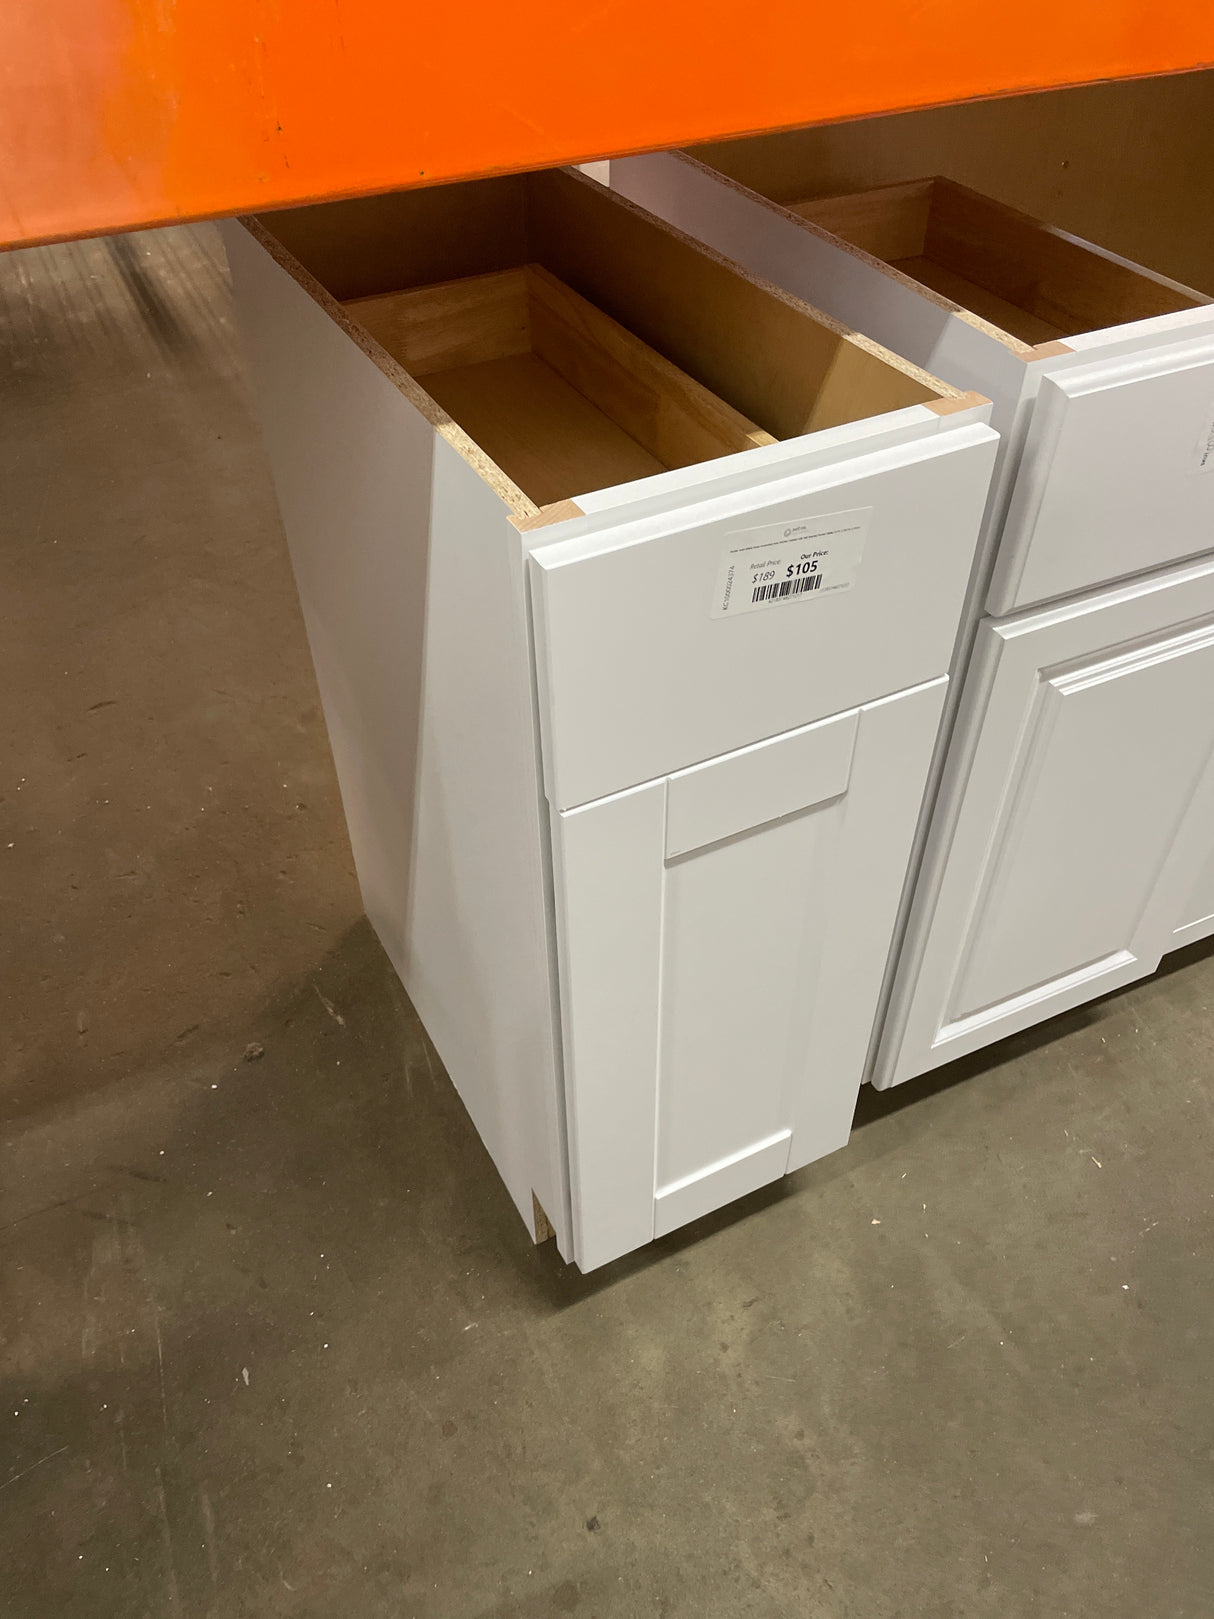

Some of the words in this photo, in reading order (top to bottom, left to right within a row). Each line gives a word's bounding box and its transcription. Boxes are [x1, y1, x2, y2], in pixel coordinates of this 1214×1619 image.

[800, 552, 811, 560] Our
[812, 550, 829, 559] Price:
[750, 561, 766, 570] Retail
[786, 560, 818, 578] $105
[752, 570, 776, 584] $189
